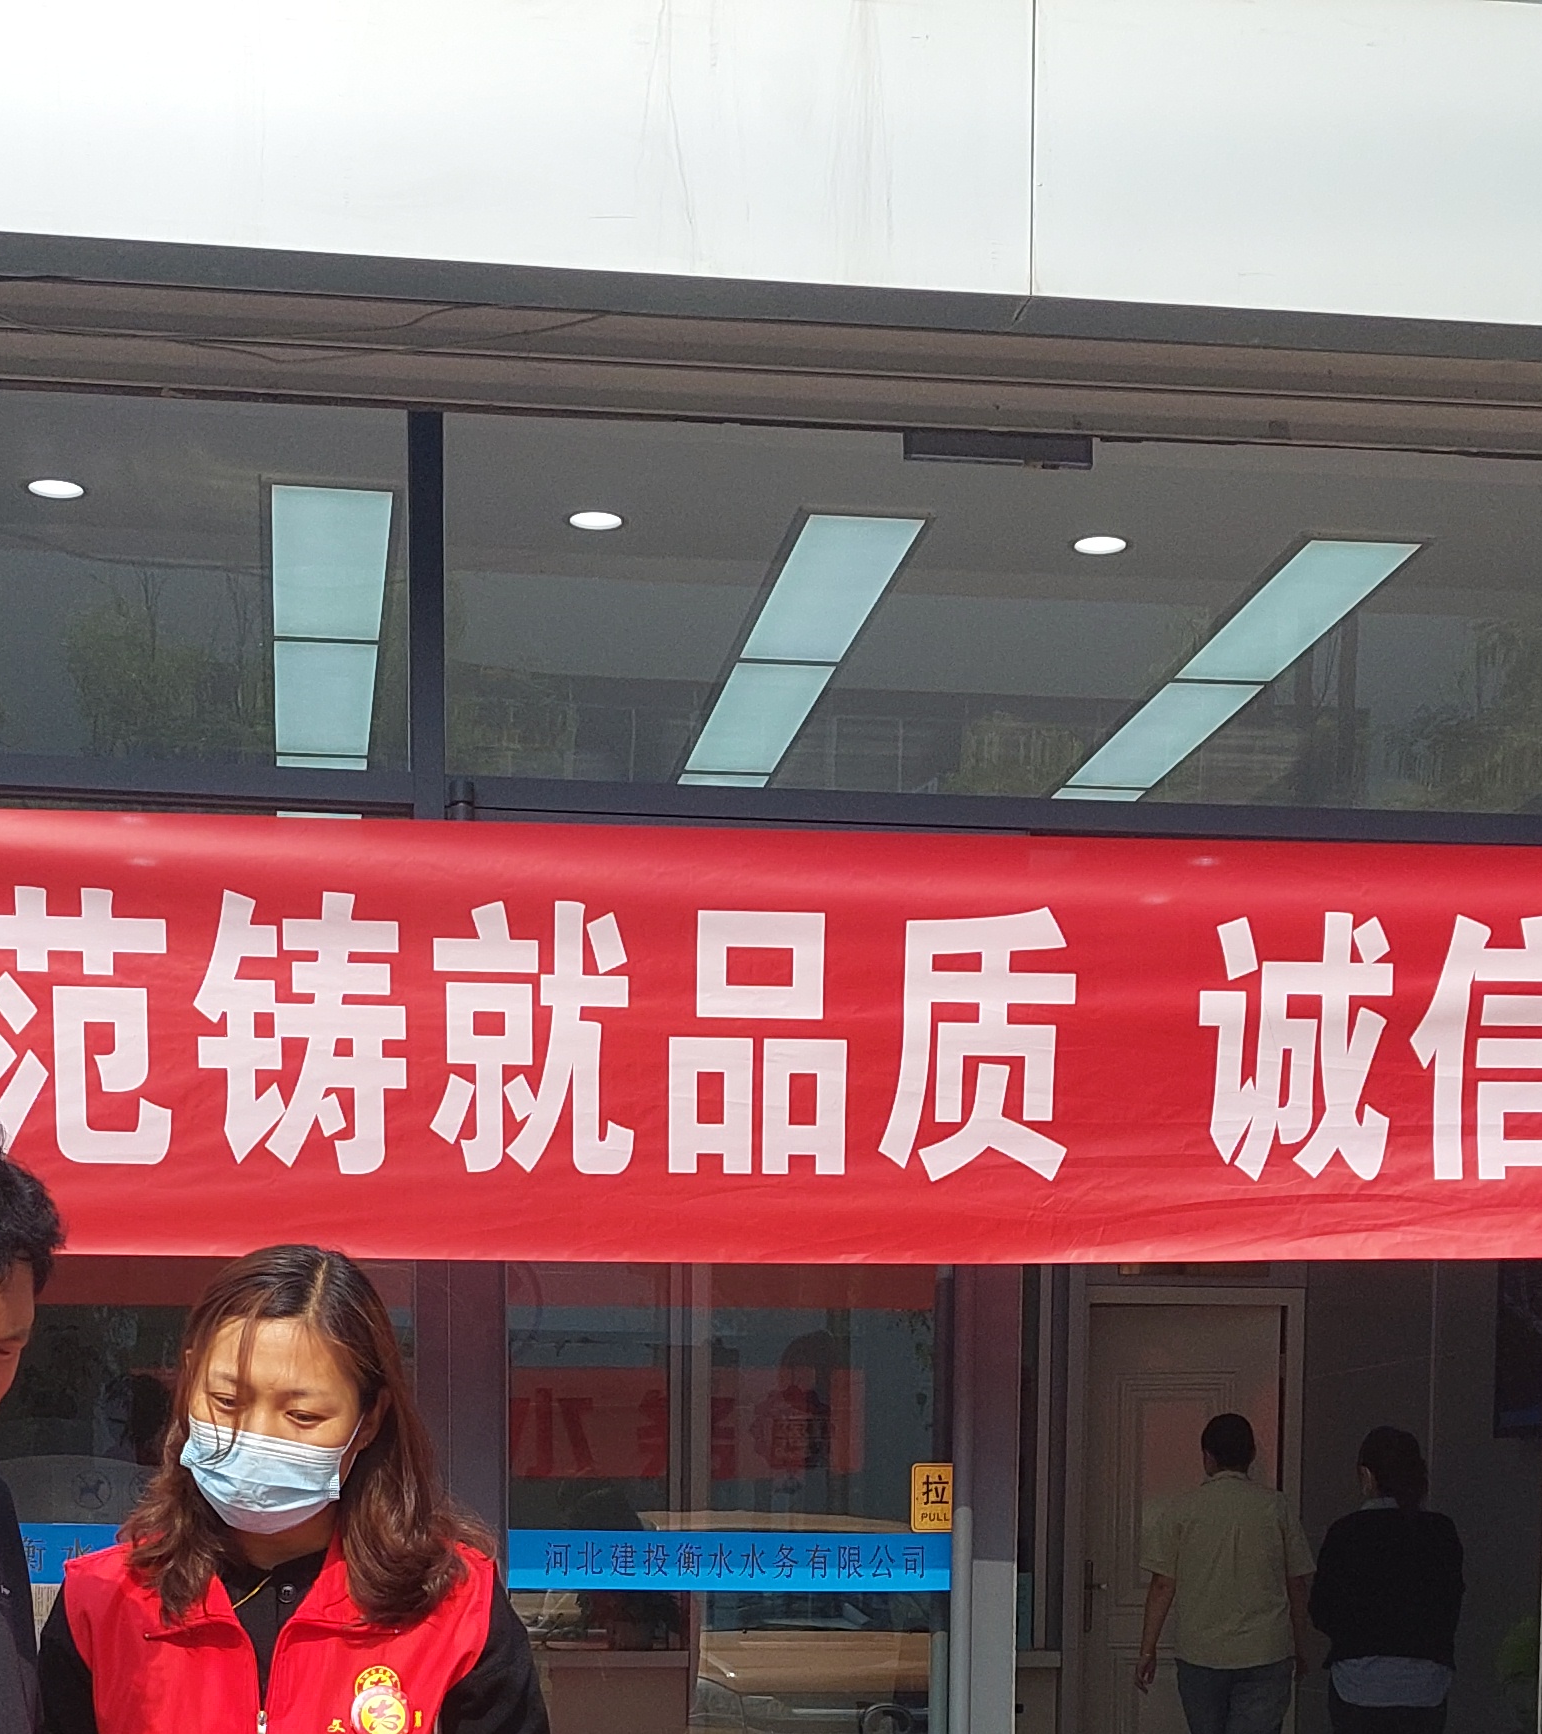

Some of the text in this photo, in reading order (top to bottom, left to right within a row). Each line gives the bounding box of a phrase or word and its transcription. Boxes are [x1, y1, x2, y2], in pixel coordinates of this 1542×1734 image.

[921, 1474, 950, 1506] 拉
[920, 1512, 951, 1522] PULL
[544, 1540, 926, 1580] 河北建投衡水水务有限公司
